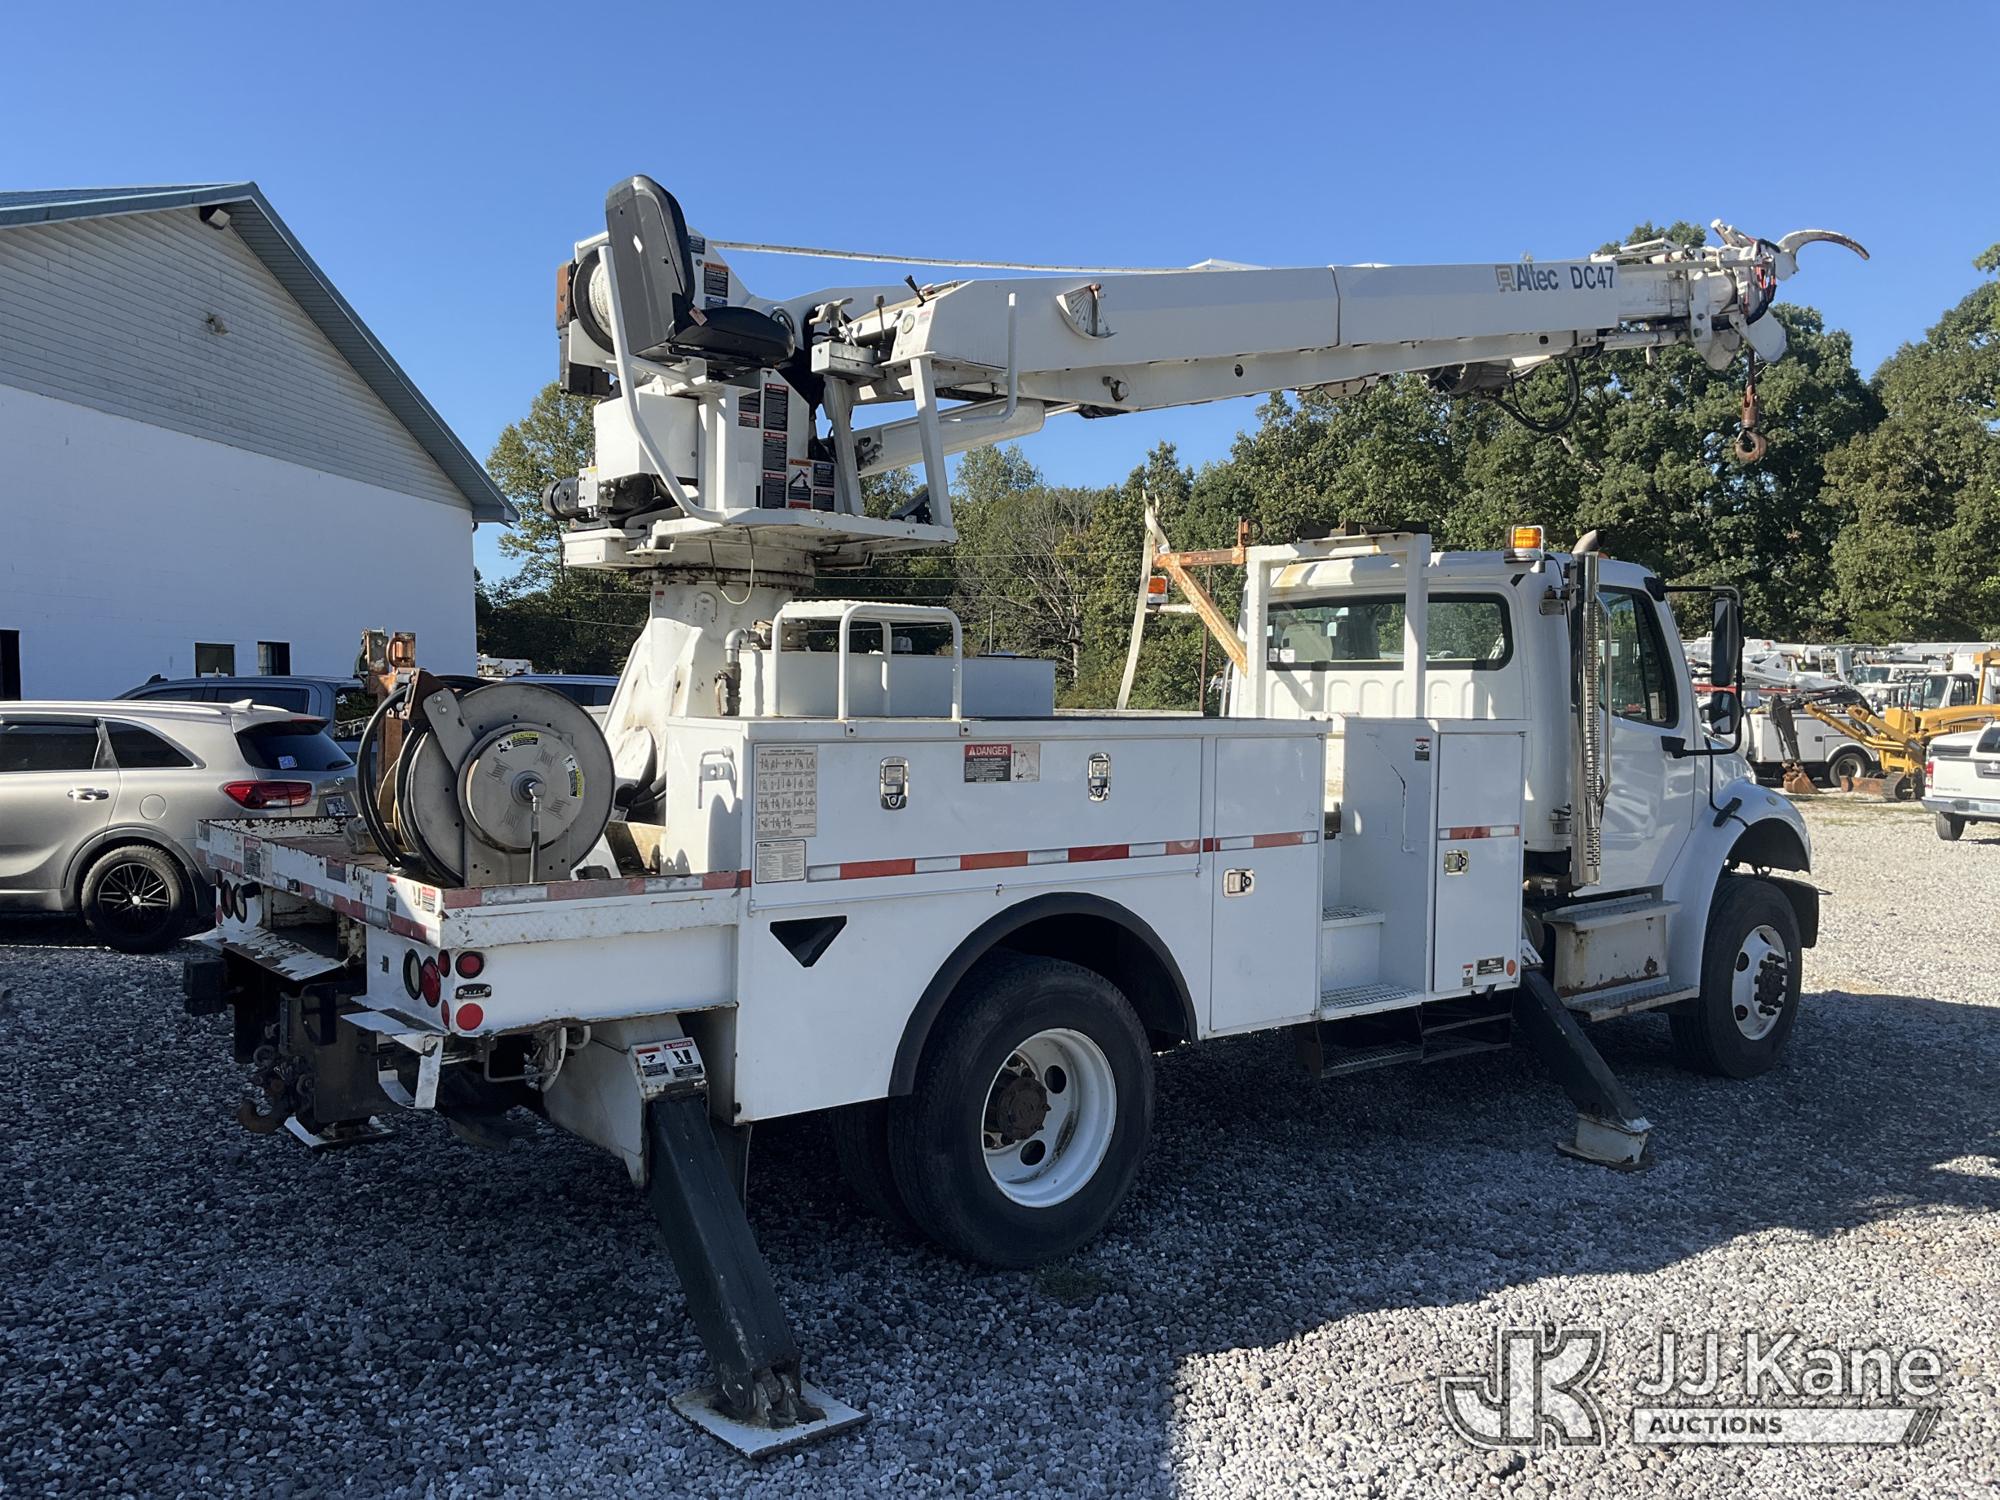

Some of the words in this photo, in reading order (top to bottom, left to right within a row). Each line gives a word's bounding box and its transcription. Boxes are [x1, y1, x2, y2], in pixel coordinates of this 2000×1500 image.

[1517, 264, 1559, 291] Altec
[1570, 265, 1614, 290] DC47
[976, 746, 1008, 755] DANGER
